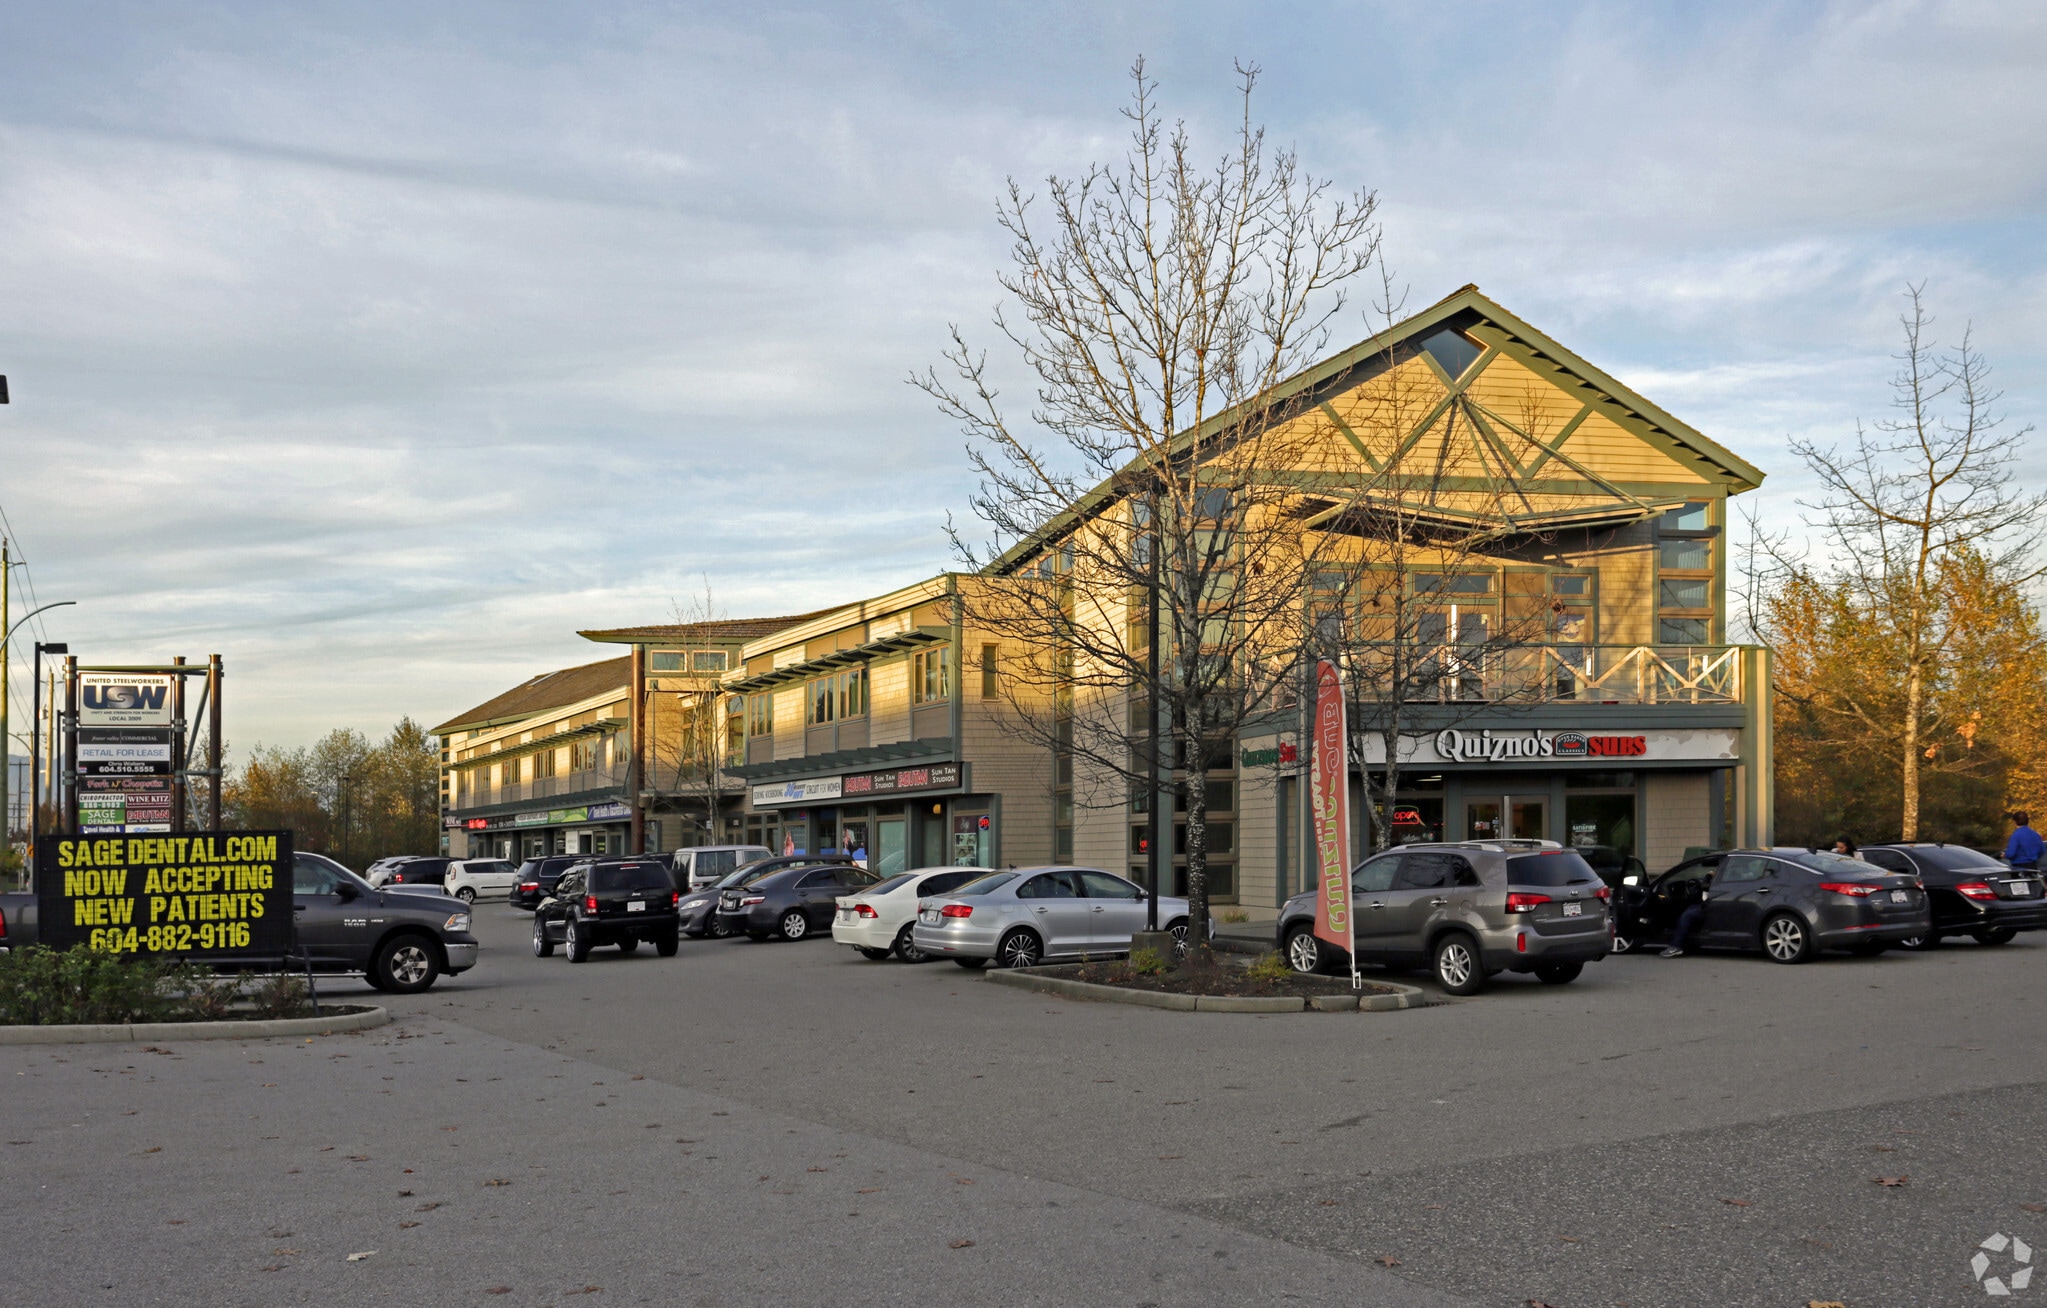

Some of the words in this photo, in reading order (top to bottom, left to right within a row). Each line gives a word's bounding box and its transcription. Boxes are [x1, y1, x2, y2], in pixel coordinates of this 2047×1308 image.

[83, 685, 168, 710] USW
[83, 749, 114, 757] RETAIL
[116, 749, 134, 757] FOR
[136, 749, 164, 757] LEASE
[1436, 729, 1553, 763] Quizno's
[1587, 736, 1647, 756] SUBS
[88, 810, 116, 819] SAGE
[58, 839, 124, 867] SAGE
[128, 836, 277, 865] DENTAL.COM
[64, 869, 128, 897] NOW
[144, 865, 273, 894] ACCEPTING
[74, 898, 135, 926] NEW
[150, 893, 265, 922] PATIENTS
[90, 922, 250, 954] 604-882-9116
